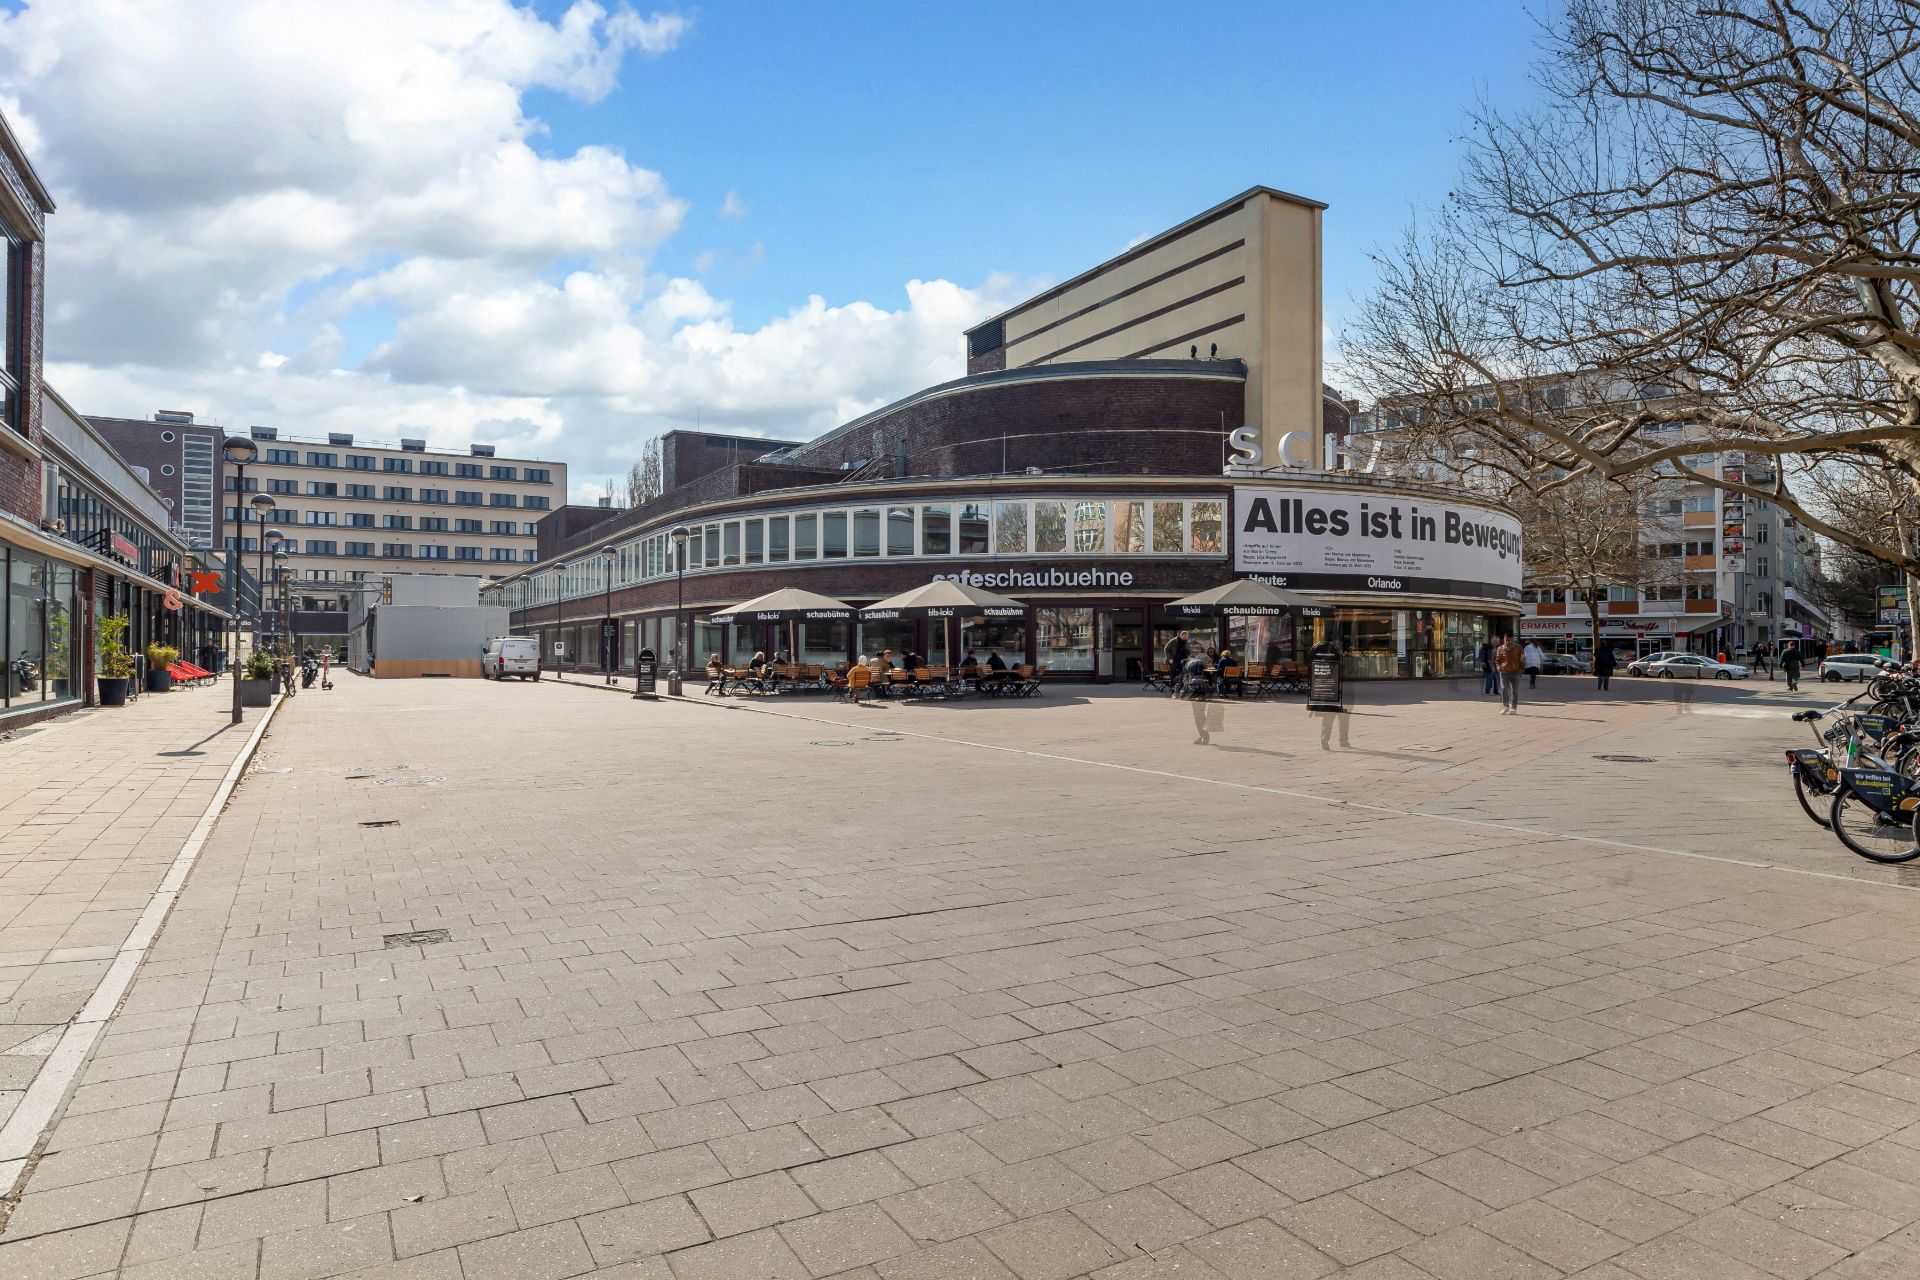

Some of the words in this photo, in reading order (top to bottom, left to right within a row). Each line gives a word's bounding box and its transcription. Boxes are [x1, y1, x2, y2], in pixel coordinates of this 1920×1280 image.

[1243, 497, 1350, 537] Alles
[1360, 502, 1403, 539] ist
[1411, 506, 1436, 542] in
[1444, 510, 1521, 564] Bewegung
[932, 567, 1133, 588] cafeschaubuehne
[1248, 573, 1287, 586] Heute:
[1367, 576, 1402, 590] Orlando
[806, 610, 850, 619] schaubühne
[983, 607, 1024, 616] schaubühne
[1223, 605, 1280, 615] schaubühne
